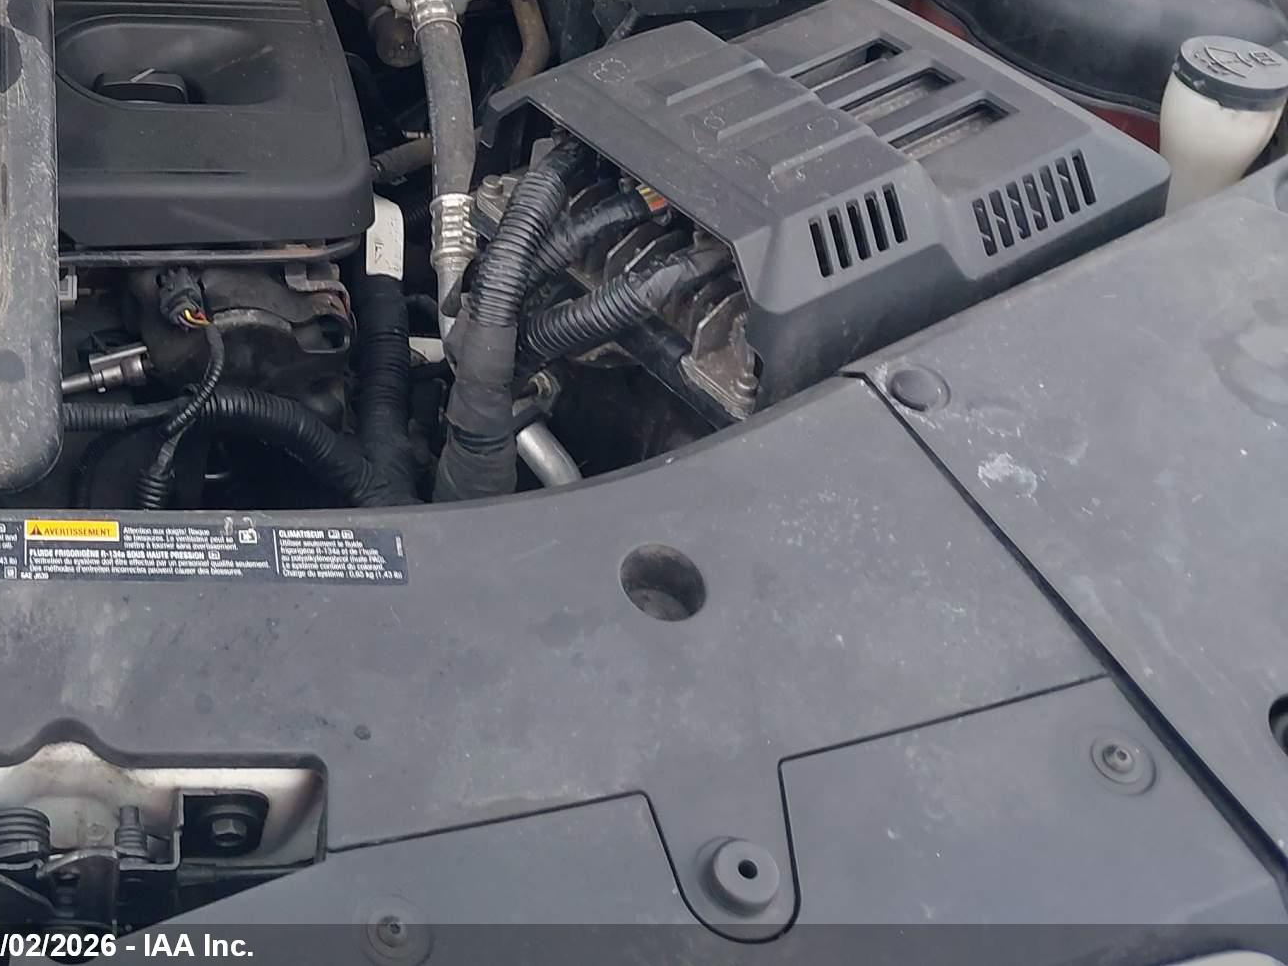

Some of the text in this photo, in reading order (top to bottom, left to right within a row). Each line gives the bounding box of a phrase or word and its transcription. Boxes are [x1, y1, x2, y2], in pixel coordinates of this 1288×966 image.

[43, 528, 111, 537] AVERTISSEMENT
[279, 530, 324, 539] CLIMATISEUR
[29, 549, 53, 559] FLUIDE
[126, 549, 146, 559] SOUS
[146, 549, 169, 559] HAUTE
[169, 549, 205, 559] PRESSION
